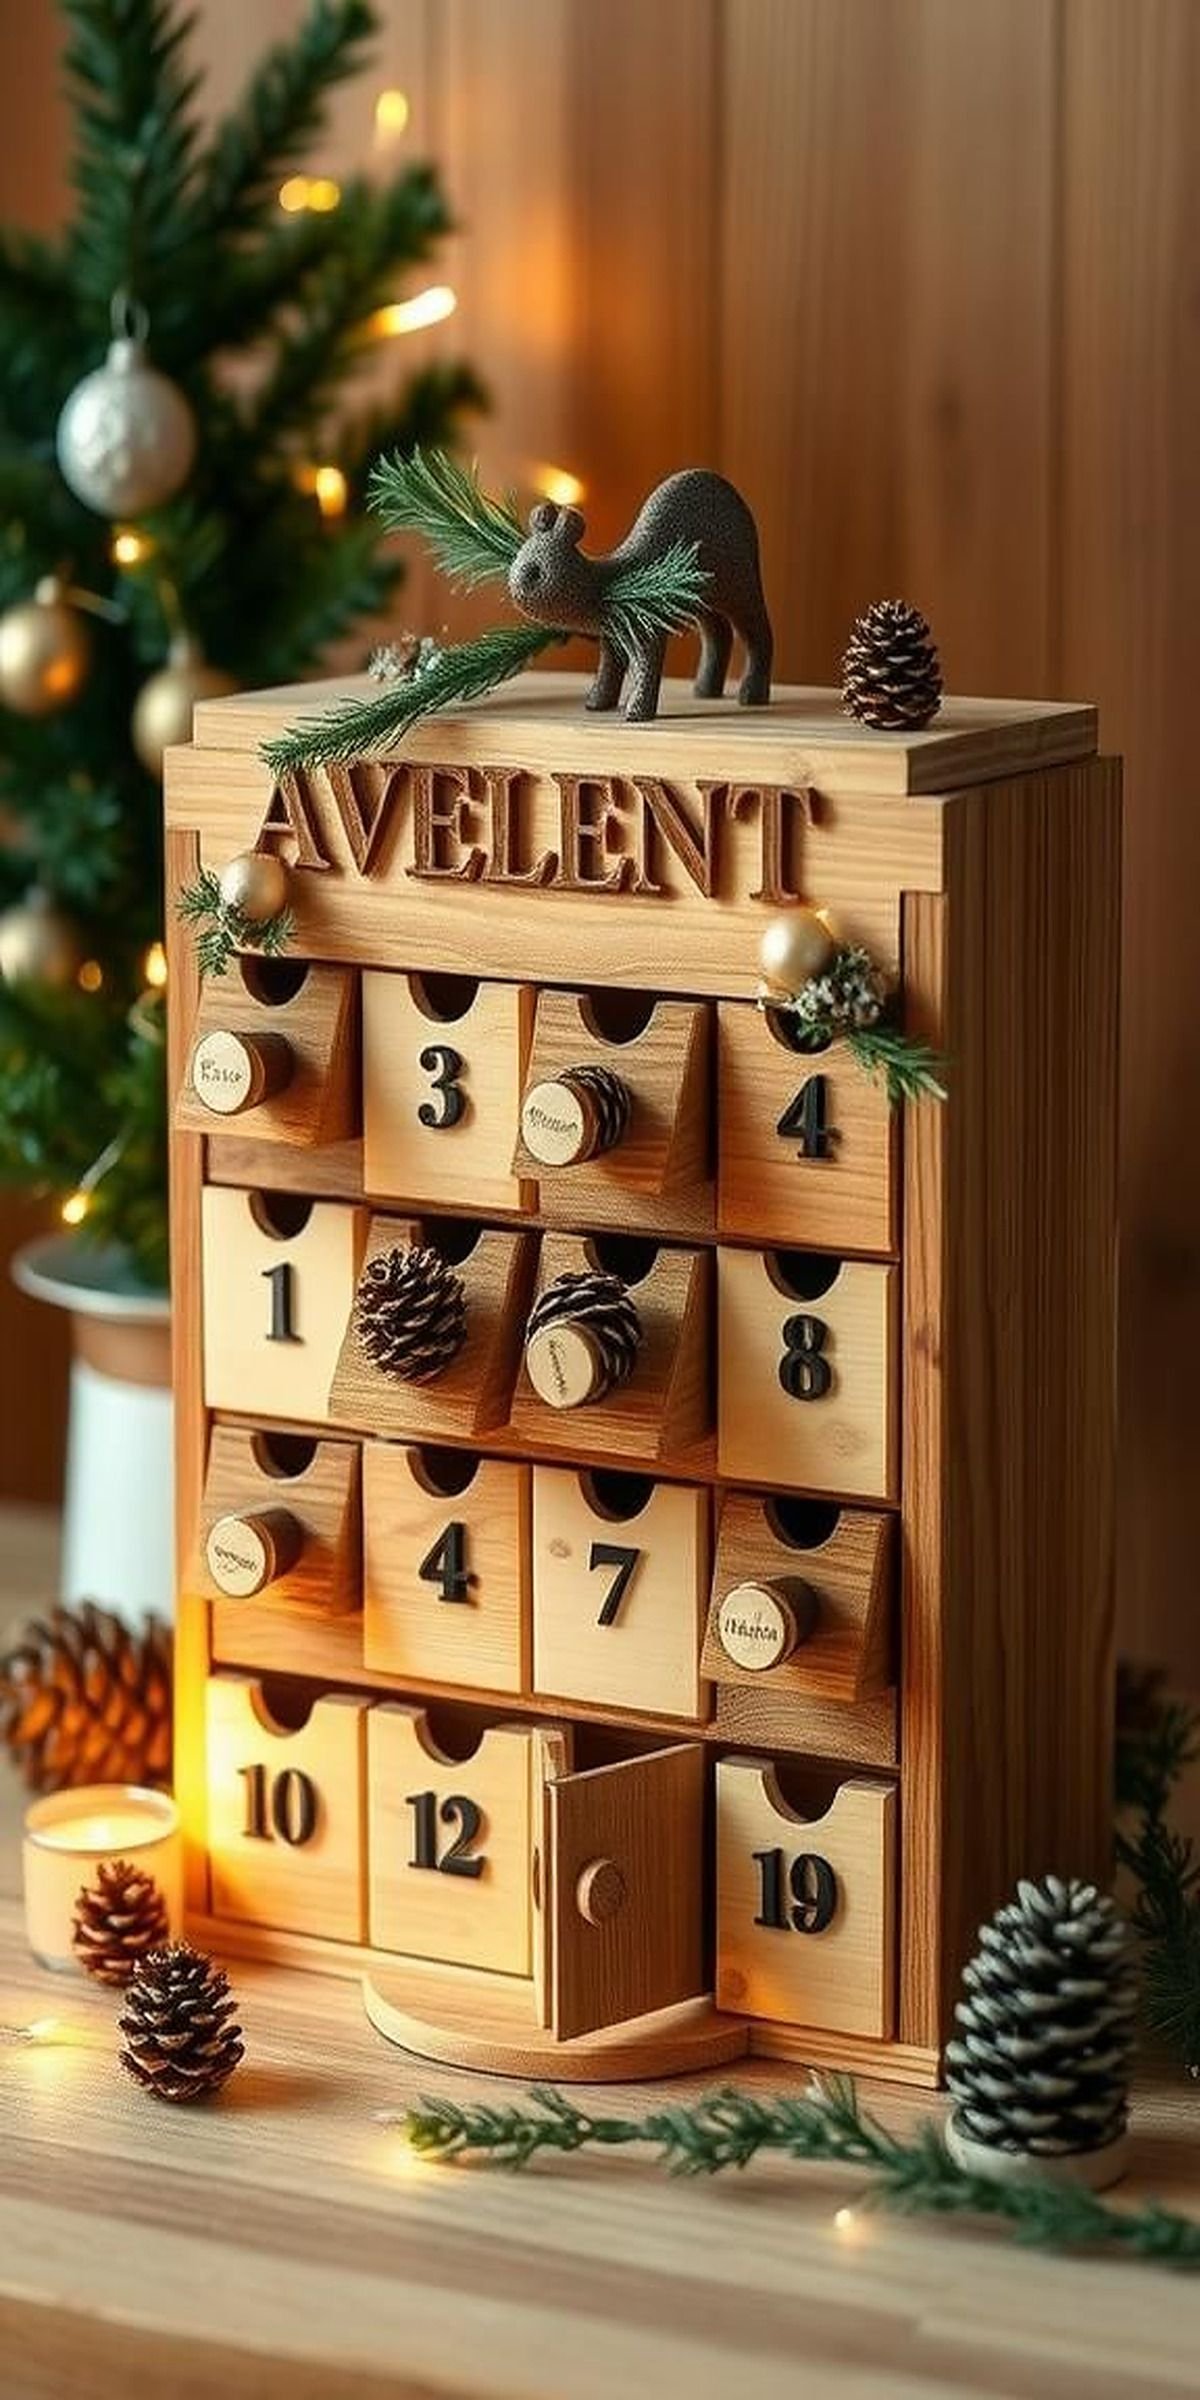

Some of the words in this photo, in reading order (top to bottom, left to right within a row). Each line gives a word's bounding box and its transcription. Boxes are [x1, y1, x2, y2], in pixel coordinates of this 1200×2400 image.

[253, 760, 824, 900] AVELENT
[417, 1045, 463, 1129] 3
[777, 1074, 838, 1160] 4
[261, 1261, 303, 1344] 1
[778, 1313, 832, 1400] 8
[417, 1521, 473, 1602] 4
[588, 1542, 641, 1625] 7
[237, 1763, 318, 1847] 10
[405, 1791, 486, 1878] 12
[751, 1847, 837, 1935] 19
